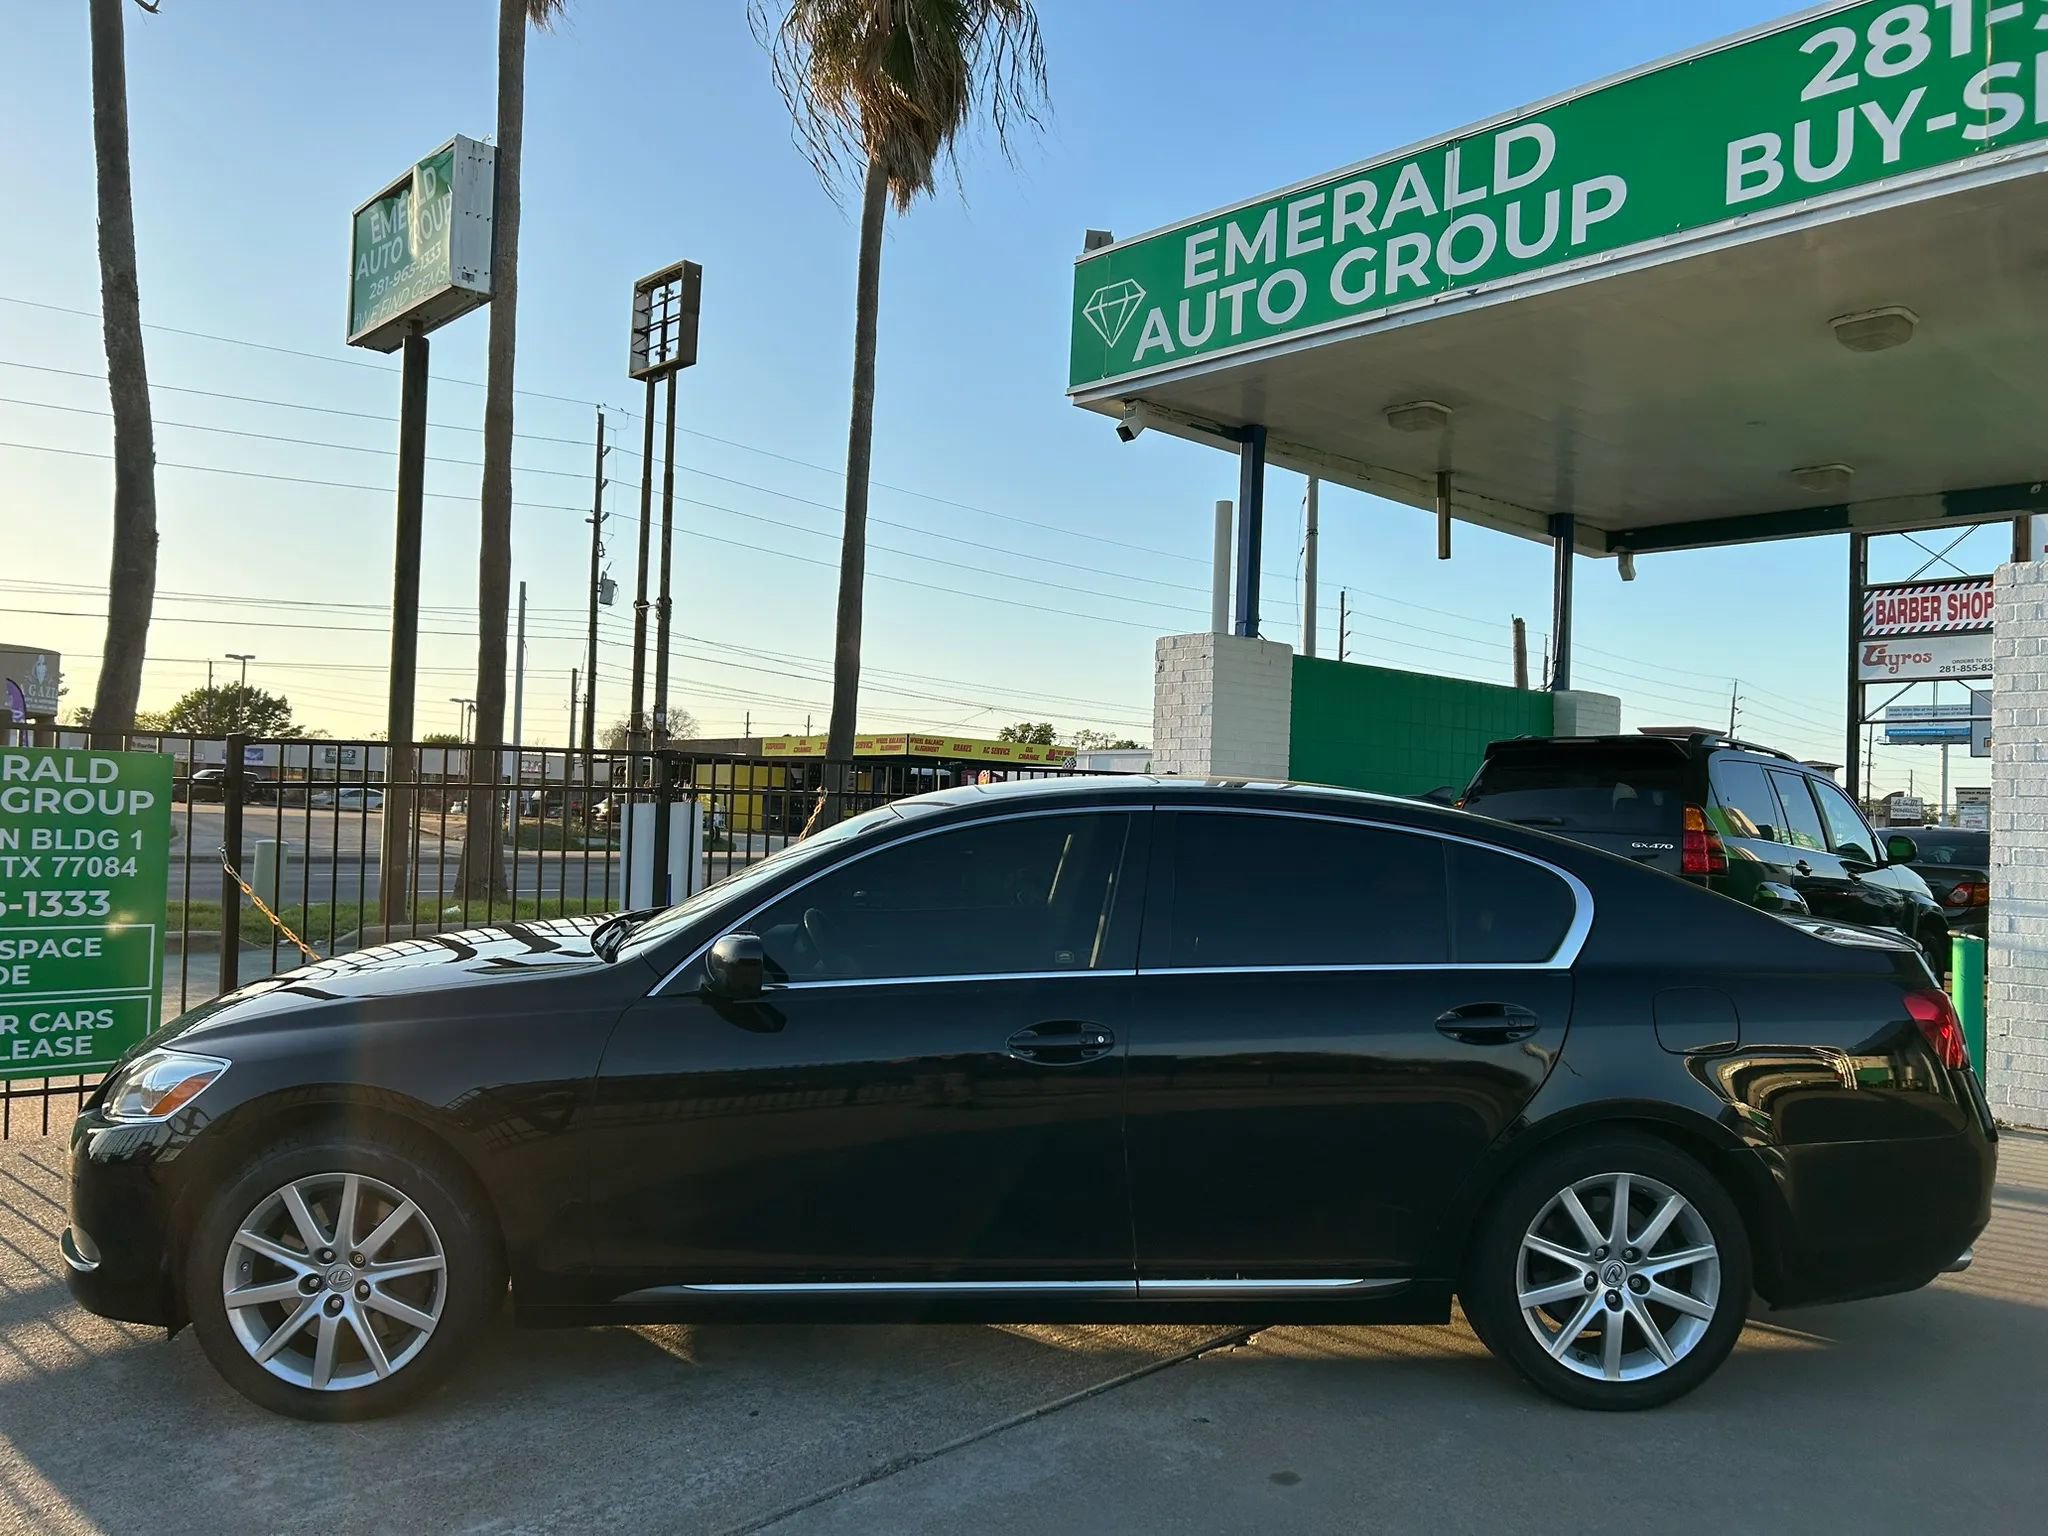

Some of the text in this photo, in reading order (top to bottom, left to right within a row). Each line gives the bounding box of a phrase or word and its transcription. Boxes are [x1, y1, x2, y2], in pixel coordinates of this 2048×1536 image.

[370, 166, 436, 244] EMERLD
[1184, 122, 1556, 289] EMERALD
[356, 236, 403, 280] AUTO
[1133, 175, 1628, 362] AUTO GROUP
[379, 287, 409, 318] FIND
[1875, 591, 1994, 626] BARBER SHOP
[1862, 644, 1932, 674] Gyros
[3, 755, 119, 784] RALD
[0, 787, 154, 815] GROUP
[0, 828, 143, 850] N BLDG 1
[0, 856, 137, 878] TX 77084
[0, 937, 102, 960] SPACE
[0, 1009, 114, 1035] R CARS
